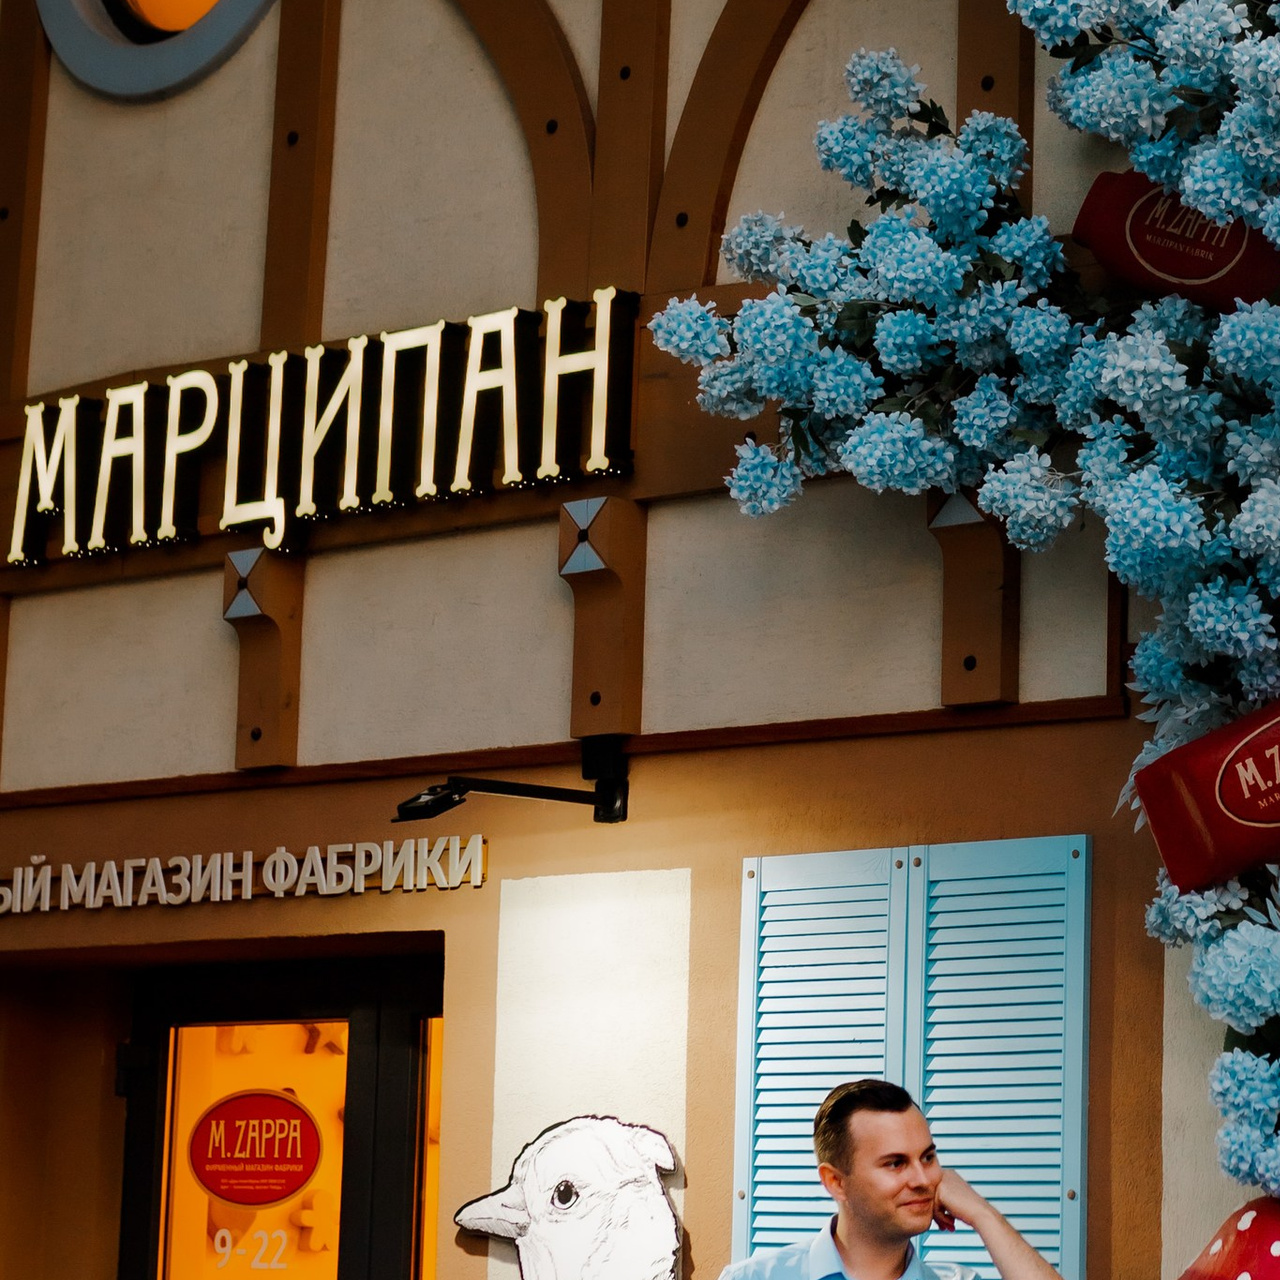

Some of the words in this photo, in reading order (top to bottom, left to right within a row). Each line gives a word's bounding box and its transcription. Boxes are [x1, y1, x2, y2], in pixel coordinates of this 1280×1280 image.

[7, 286, 617, 564] МАРЦИПАН
[60, 851, 252, 910] МАГАЗИН
[262, 834, 483, 897] ФАБРИКИ
[207, 1119, 302, 1159] M.ZAPPA
